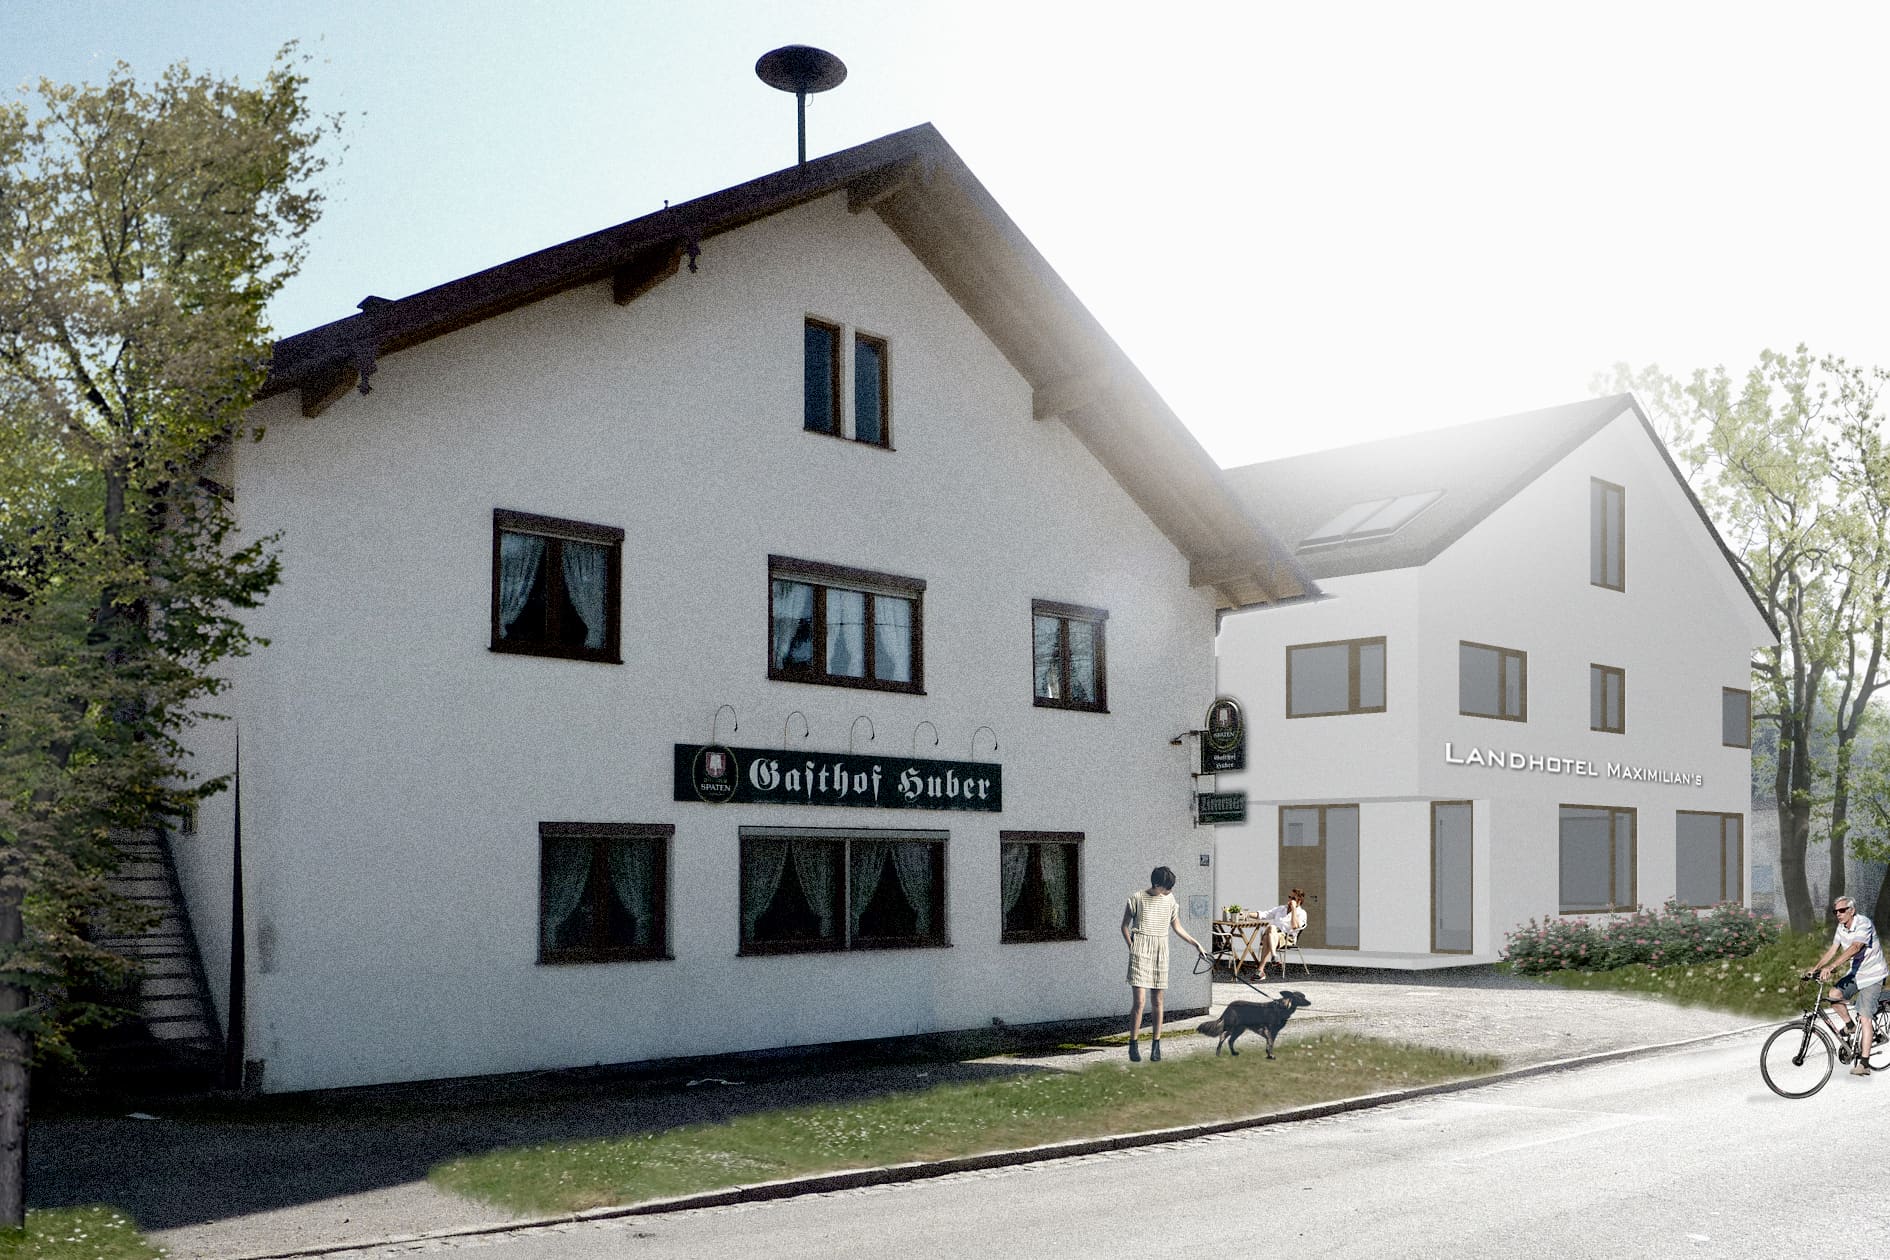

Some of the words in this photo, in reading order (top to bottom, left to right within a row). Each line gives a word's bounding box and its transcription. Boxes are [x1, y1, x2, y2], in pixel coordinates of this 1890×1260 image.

[1445, 742, 1598, 777] LANDHOTEL
[700, 783, 731, 792] SPATEN
[898, 767, 990, 802] Huber
